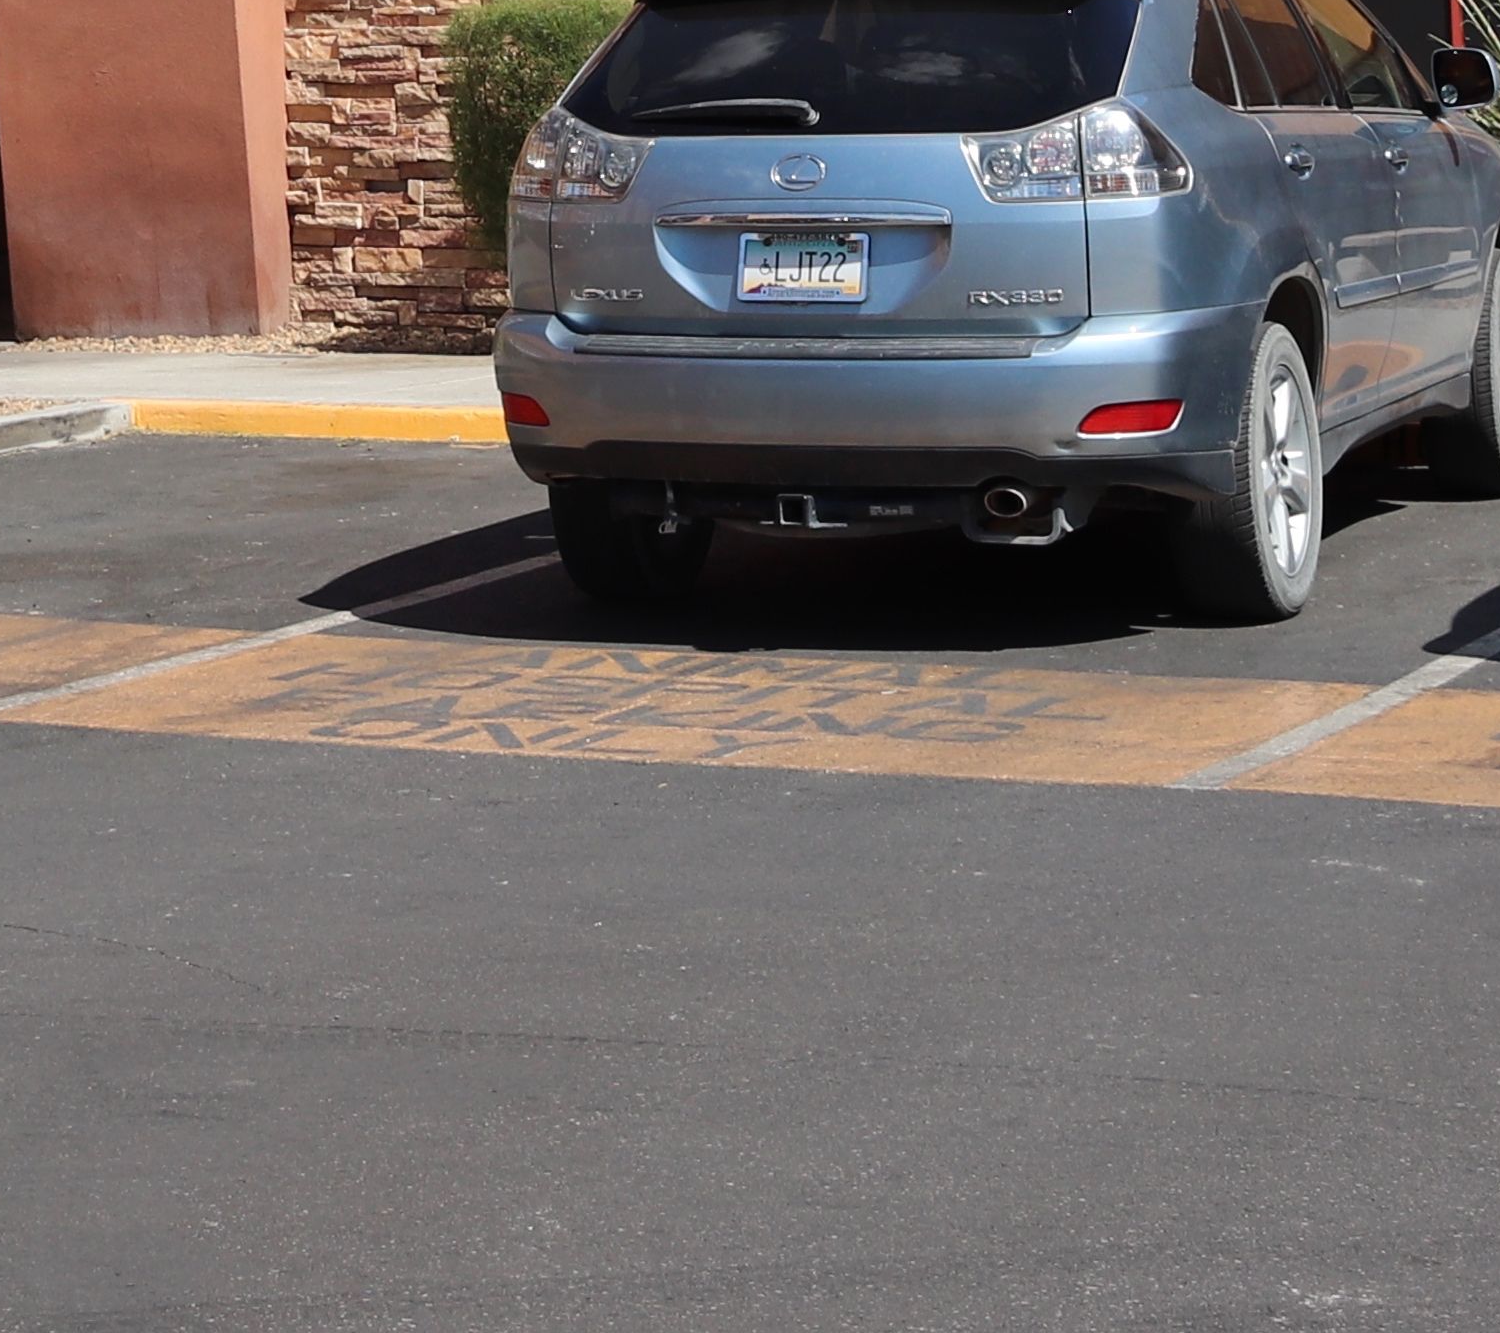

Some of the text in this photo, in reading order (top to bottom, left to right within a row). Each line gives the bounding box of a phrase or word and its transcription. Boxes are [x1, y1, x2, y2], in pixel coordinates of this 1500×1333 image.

[775, 251, 847, 282] LJT22
[570, 288, 643, 301] LEXUS
[461, 649, 1039, 692] ANIMAL
[268, 663, 1106, 721] HOSPITAL
[250, 688, 1027, 743] PARKING
[308, 718, 809, 758] ONLY
